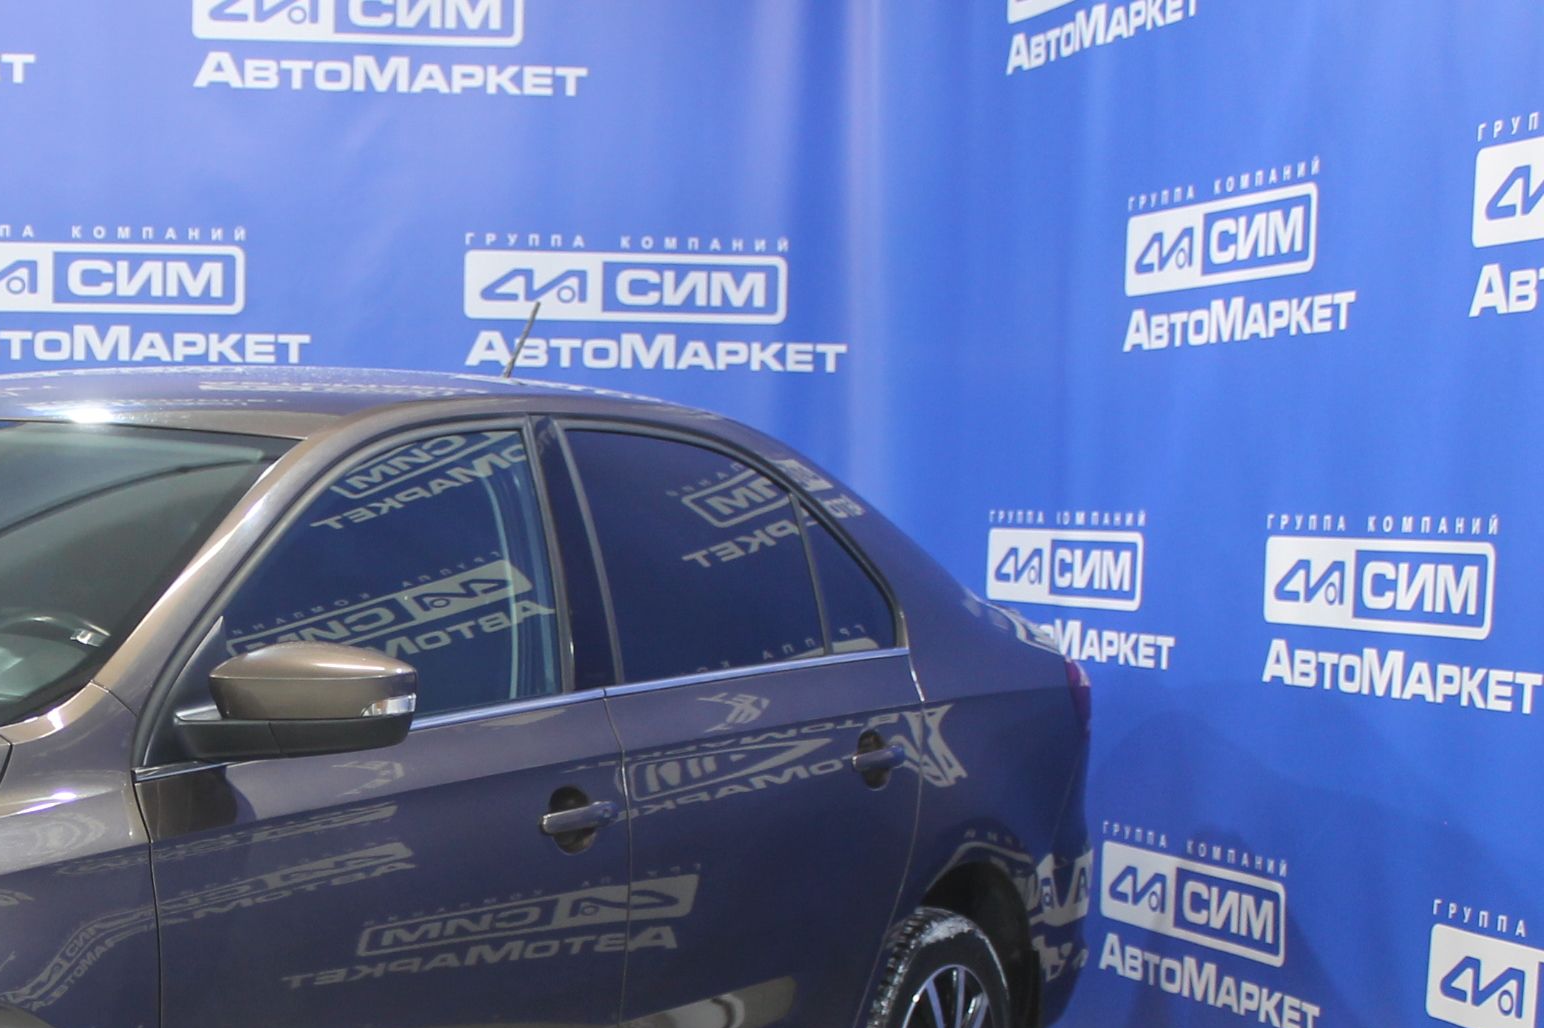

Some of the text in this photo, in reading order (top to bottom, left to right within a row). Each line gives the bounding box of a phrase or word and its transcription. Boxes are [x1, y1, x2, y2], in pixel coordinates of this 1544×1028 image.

[1128, 156, 1321, 211] ГРУППА КОМПАНИЙ
[71, 225, 247, 242] КОМПАНИЙ
[465, 231, 789, 253] ГРУППА КОМПАНИЙ
[1207, 204, 1305, 267] СИМ
[67, 258, 224, 297] СИМ
[616, 269, 768, 307] СИМ
[989, 509, 1046, 525] ГРУППА
[1267, 513, 1500, 536] ГРУППА КОМПАНИЙ
[1055, 547, 1132, 592] СИМ
[1362, 561, 1480, 615] СИМ
[1103, 820, 1289, 878] ГРУППА КОМПАНИЙ
[1182, 878, 1276, 945] СИМ
[1432, 898, 1527, 938] ГРУППА
